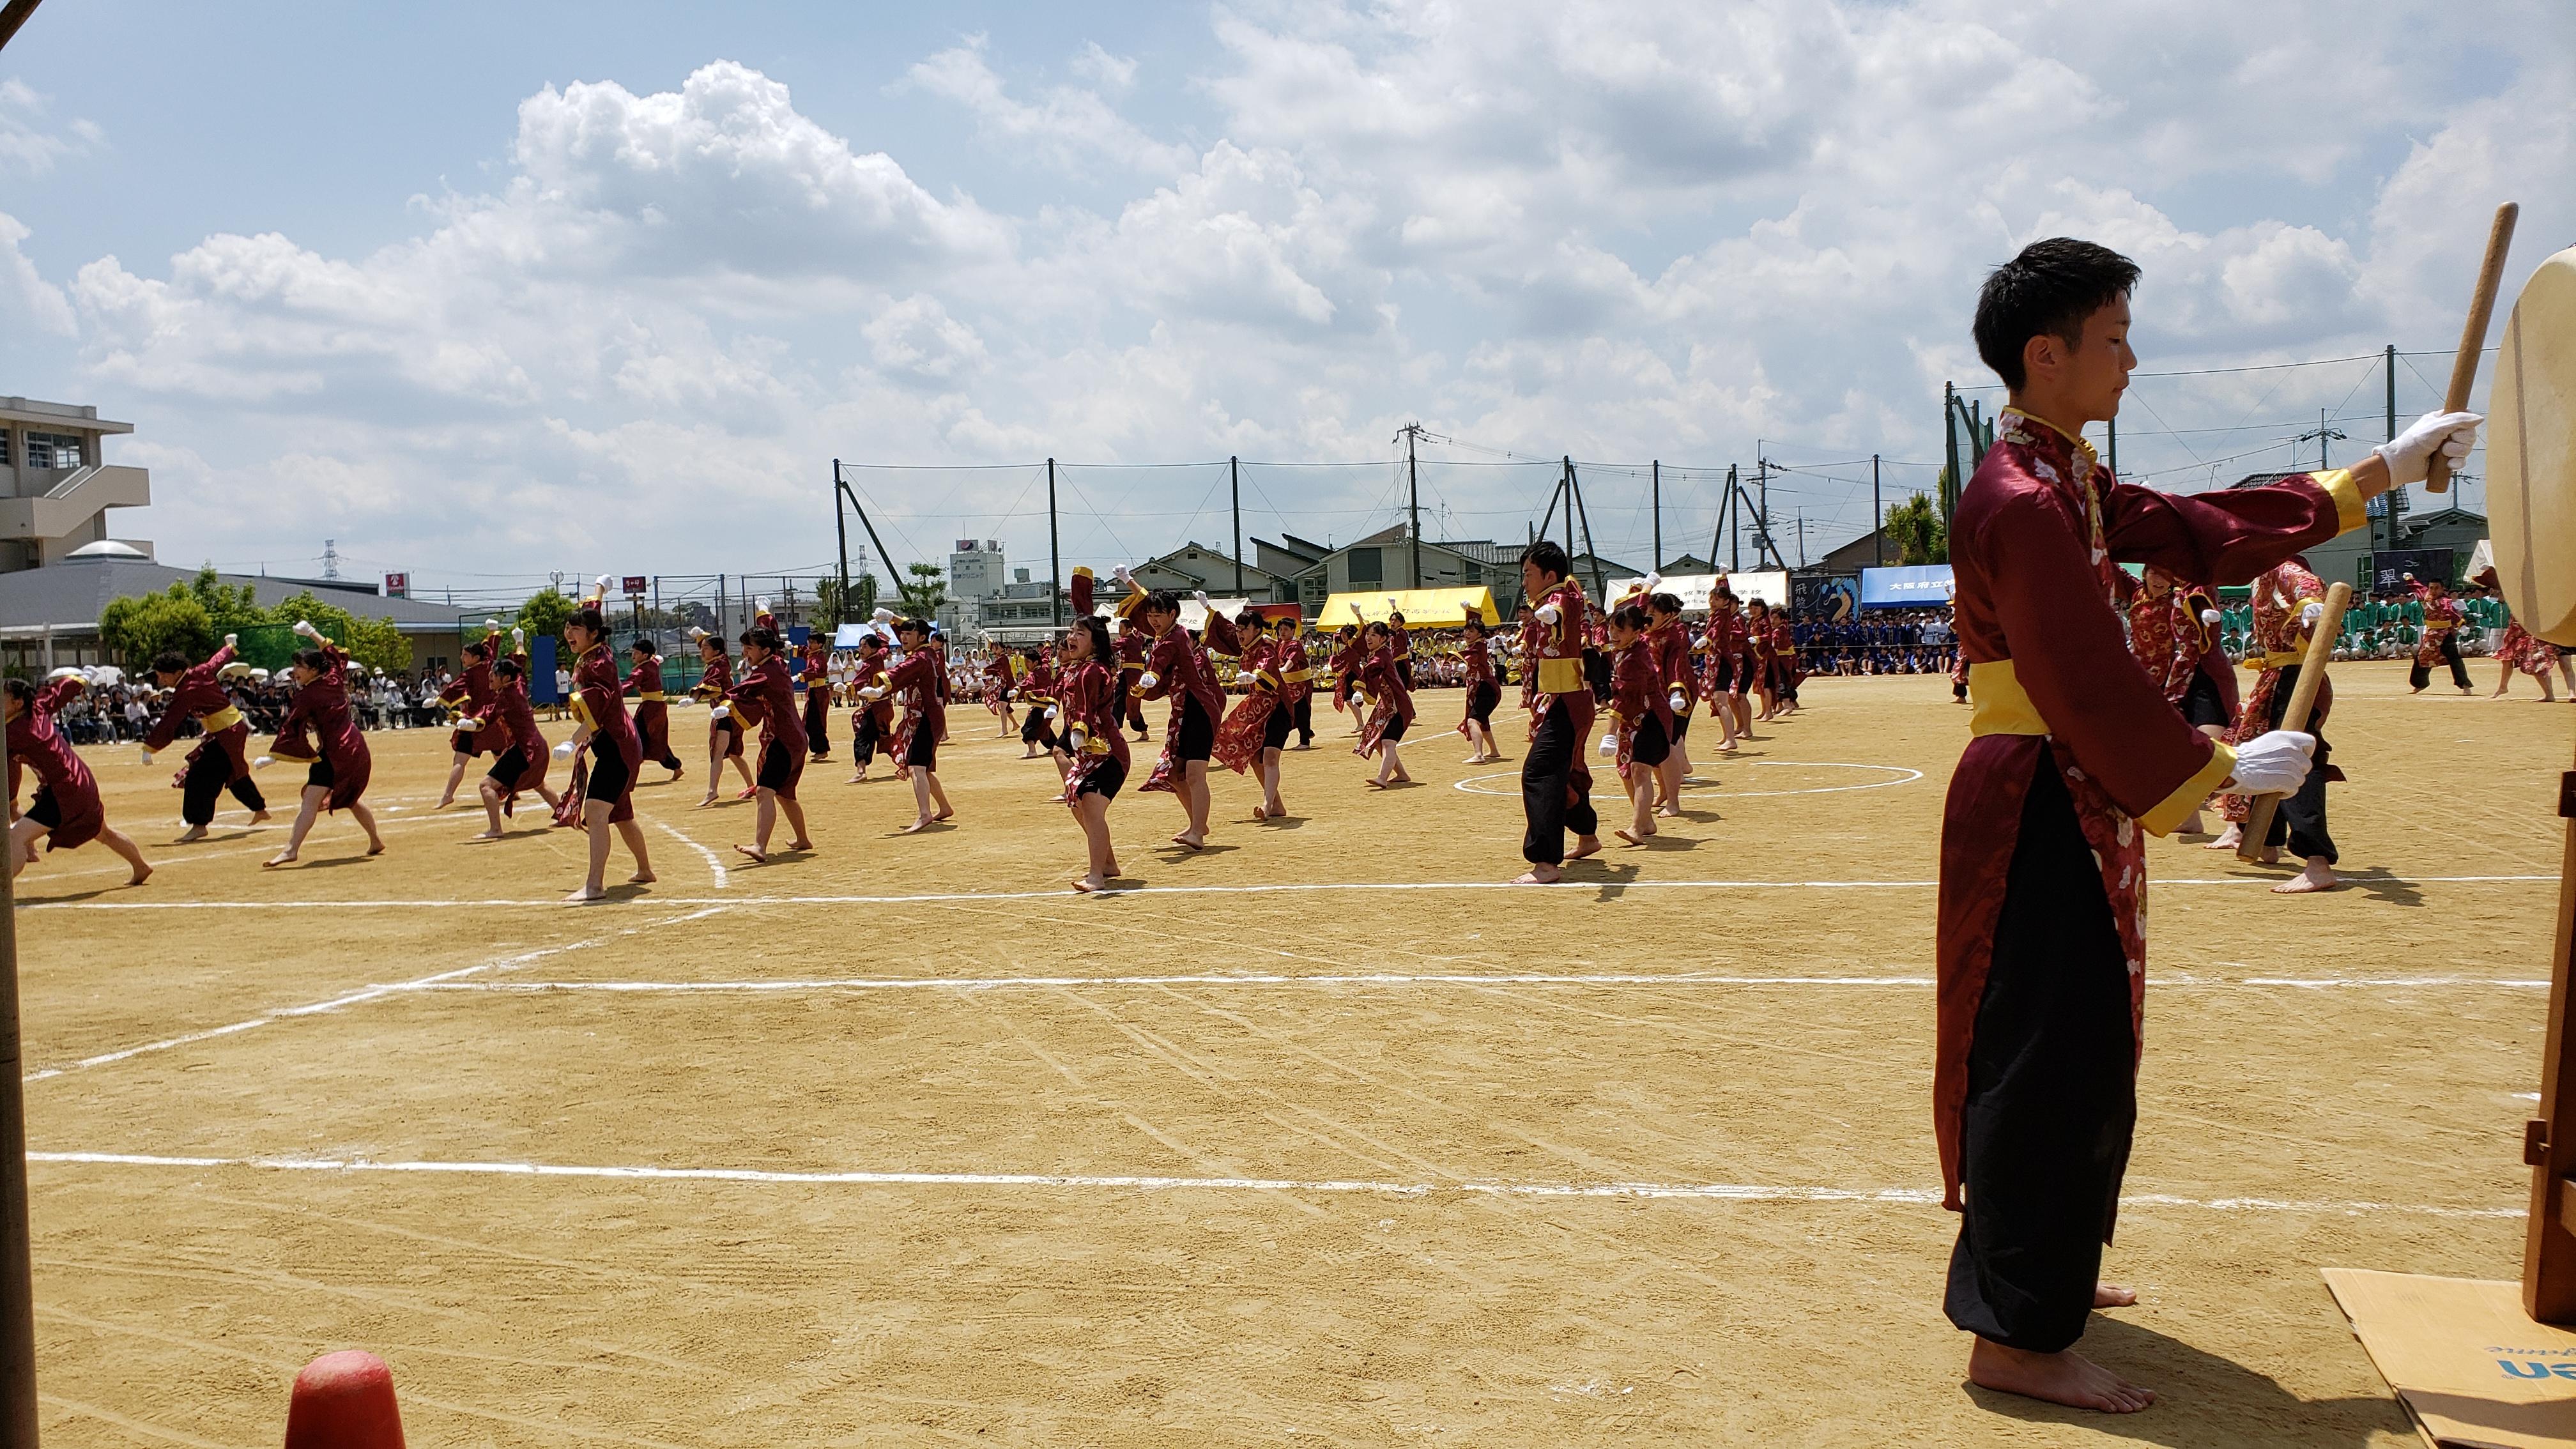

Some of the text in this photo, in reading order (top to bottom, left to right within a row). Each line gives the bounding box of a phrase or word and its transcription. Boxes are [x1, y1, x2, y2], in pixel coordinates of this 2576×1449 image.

[1889, 579, 1954, 590] 大阪府立
[2379, 569, 2400, 588] 翠
